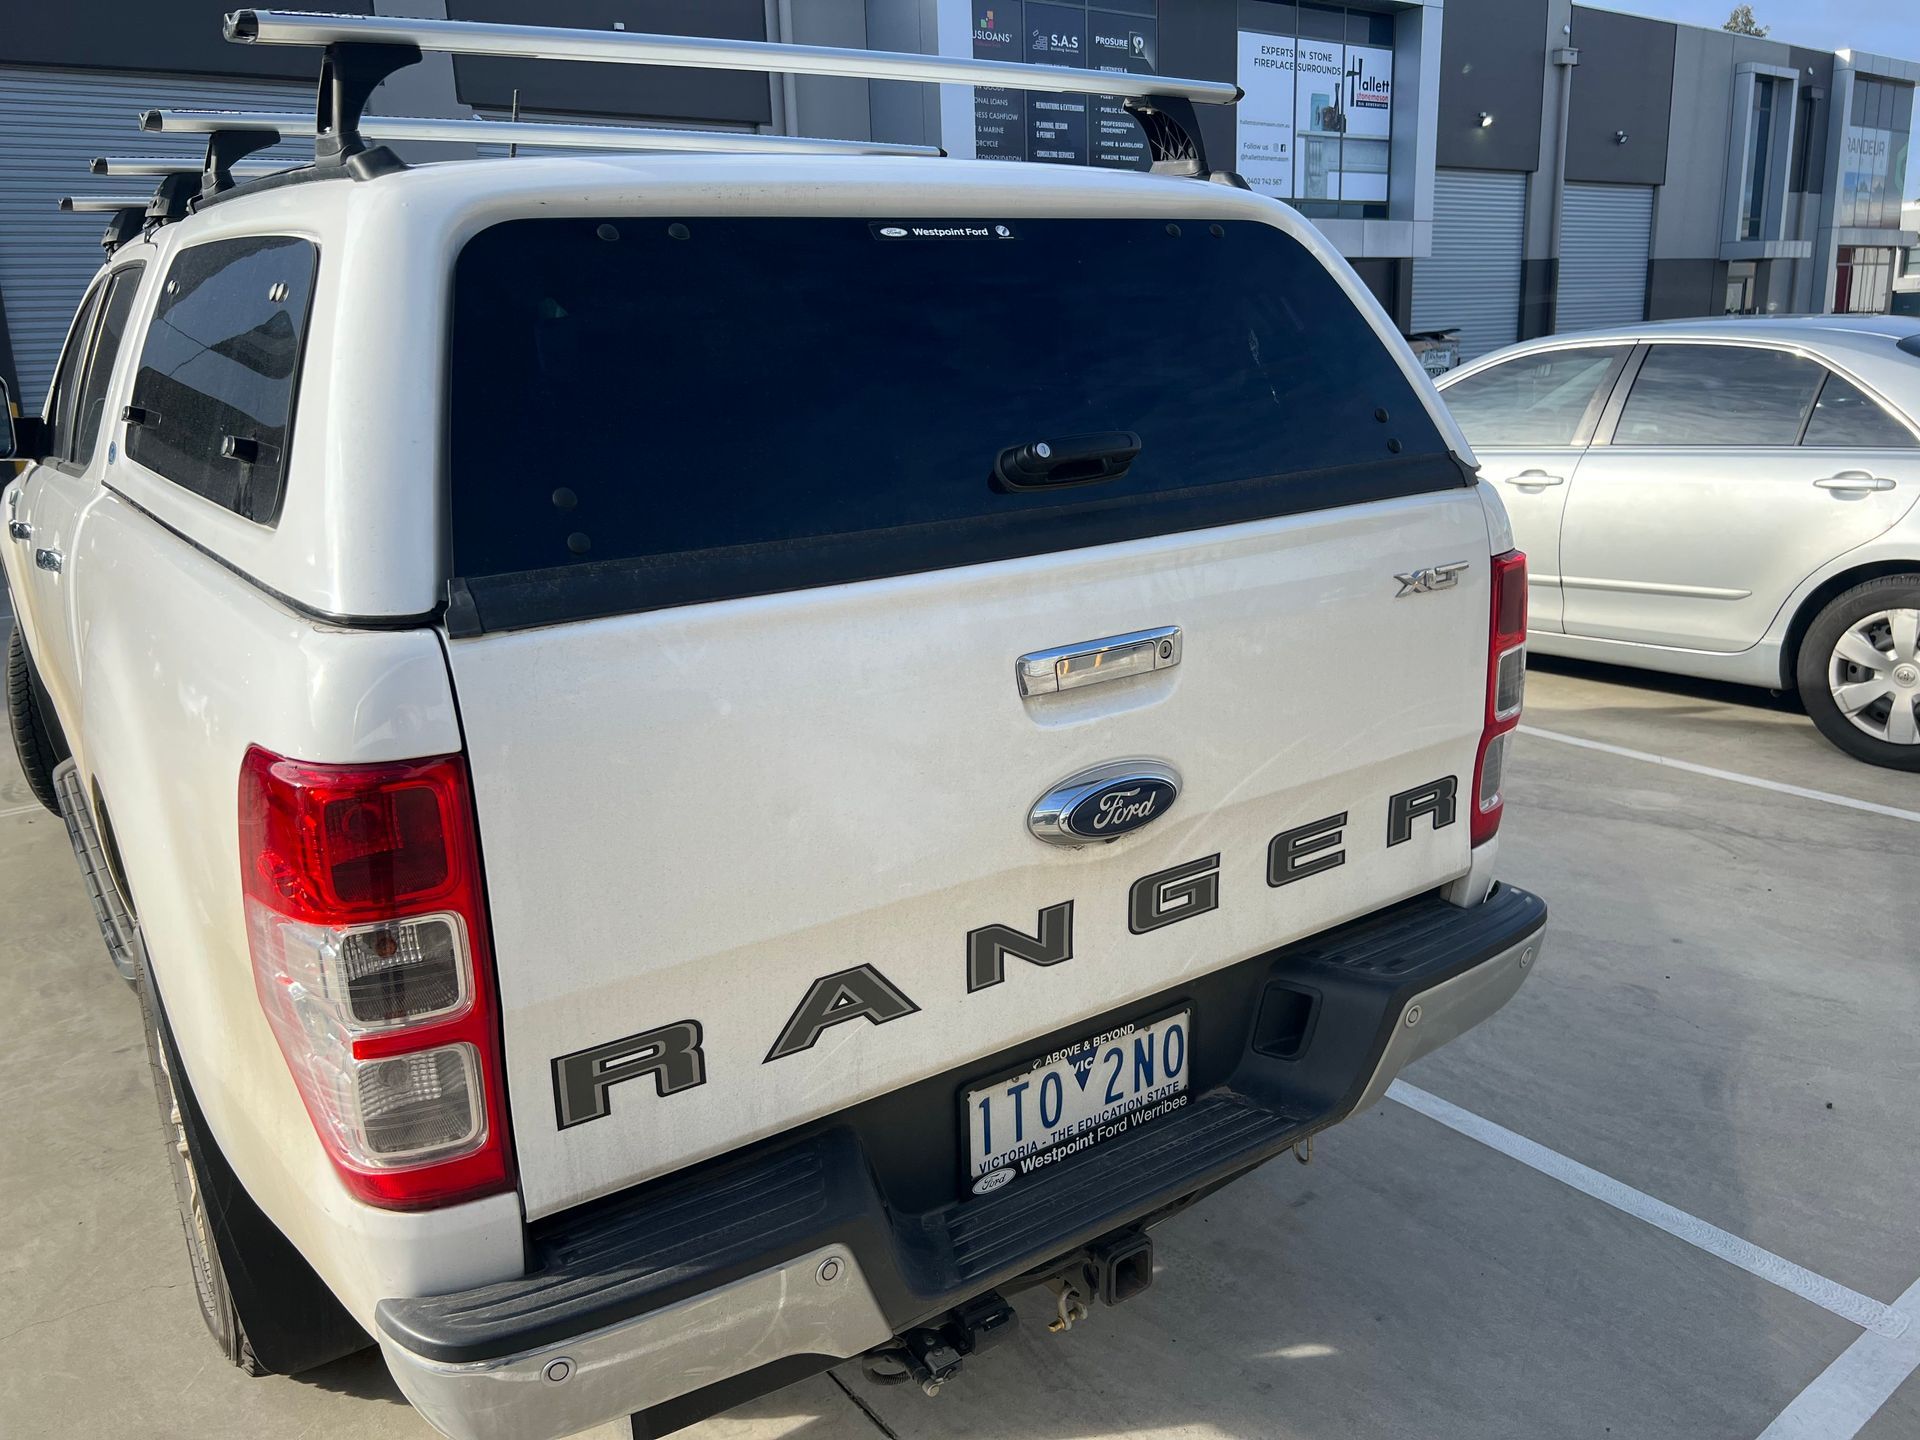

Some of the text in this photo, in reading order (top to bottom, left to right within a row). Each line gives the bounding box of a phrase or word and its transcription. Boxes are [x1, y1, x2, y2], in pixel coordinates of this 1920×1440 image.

[1051, 34, 1078, 48] S.A.S
[1261, 45, 1333, 62] EXPERTS IN STONE
[1254, 57, 1341, 76] FIREPLACE SURROUNDS
[990, 98, 1008, 106] LOANS
[989, 112, 1018, 121] CASHFLOW
[1100, 120, 1135, 128] PROFESSIONAL
[983, 126, 1004, 134] MARINE
[1243, 142, 1261, 150] Follow
[912, 228, 989, 237] Westpoint Ford
[1393, 560, 1470, 598] XLT
[1093, 788, 1157, 829] Ford
[550, 774, 1458, 1131] RANGER
[1044, 1023, 1135, 1067] ABOVE & BEYOND
[1071, 1056, 1094, 1076] VIC
[979, 1140, 1038, 1175] VICTORIA
[1050, 1126, 1074, 1145] THE
[1077, 1096, 1144, 1135] EDUCATION
[1146, 1081, 1180, 1104] STATE
[1020, 1132, 1095, 1174] Westpoint
[1097, 1117, 1128, 1144] Ford
[1131, 1093, 1188, 1127] Werribee
